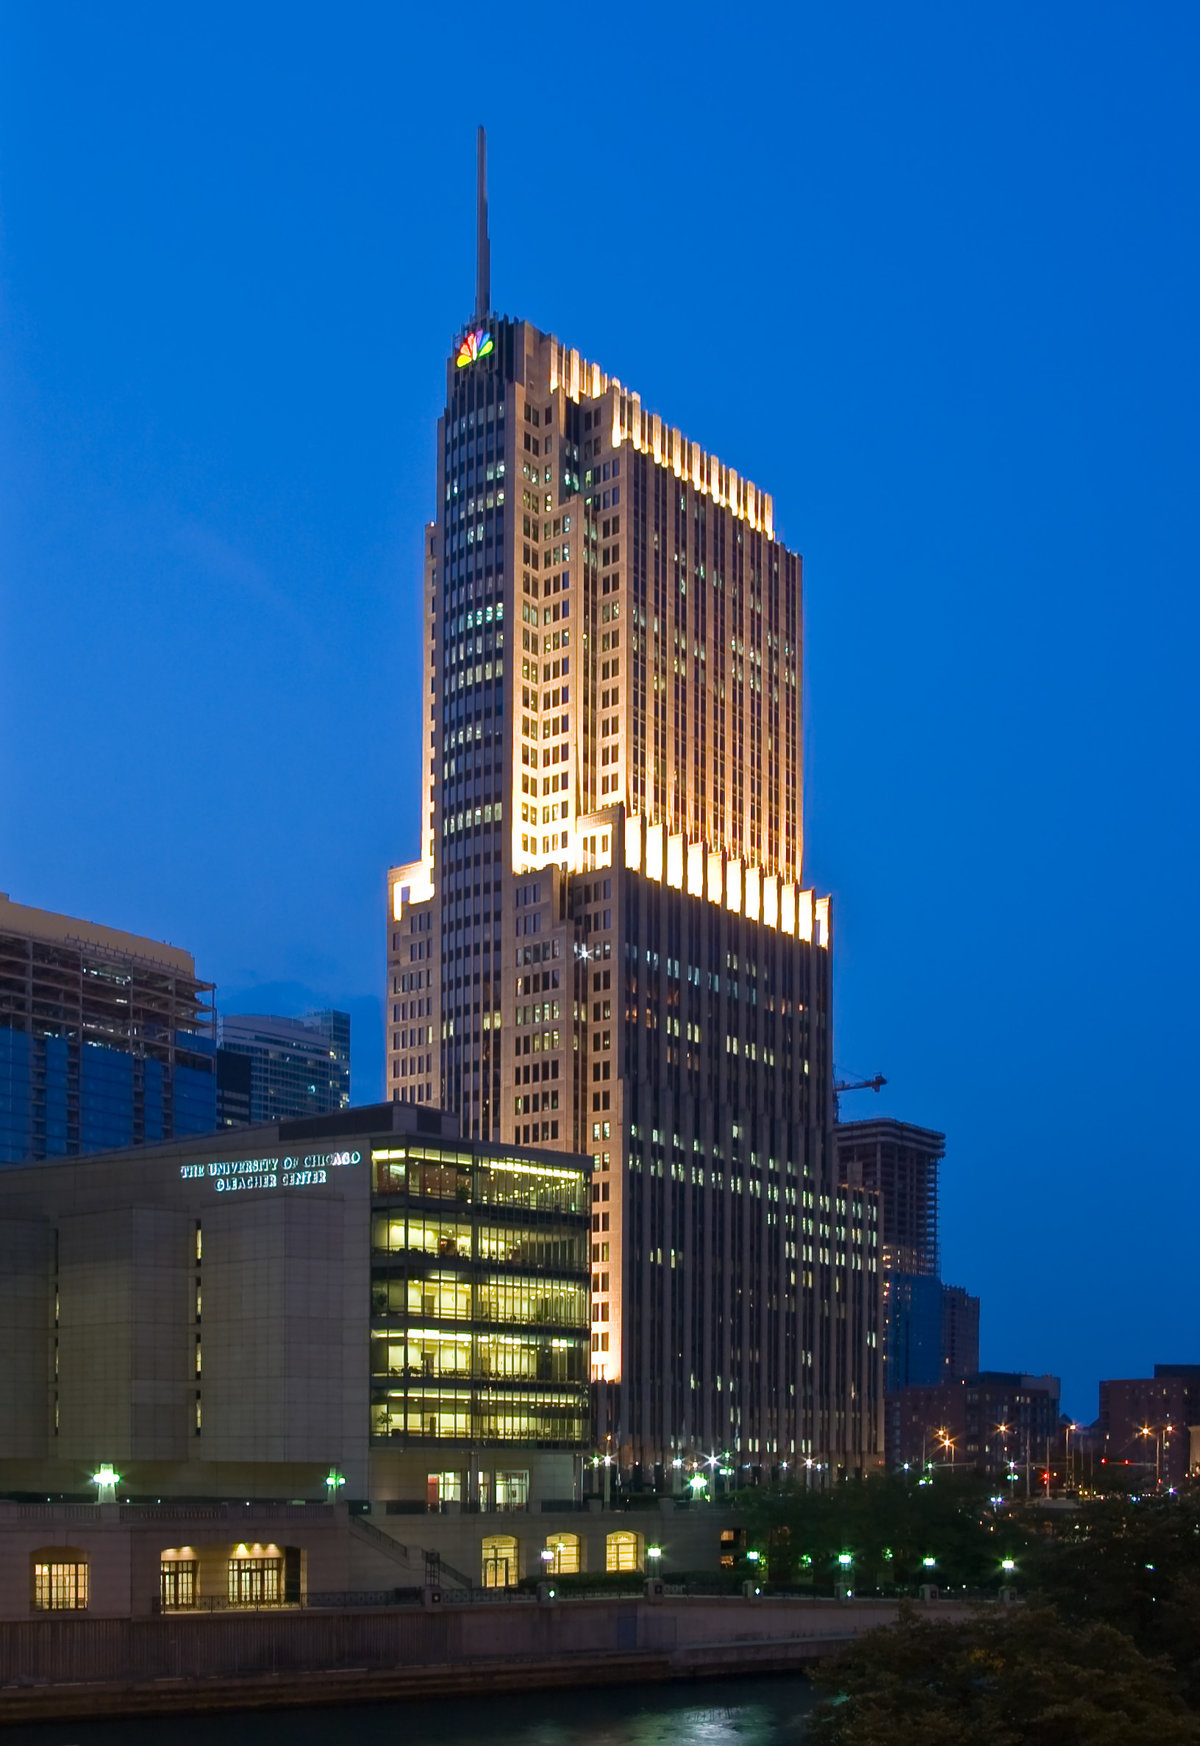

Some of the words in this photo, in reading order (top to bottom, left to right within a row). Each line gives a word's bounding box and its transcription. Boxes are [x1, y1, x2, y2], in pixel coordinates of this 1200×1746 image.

[180, 1165, 205, 1180] THE
[207, 1158, 279, 1176] UNIVERSITY
[282, 1156, 300, 1170] OF
[304, 1151, 361, 1168] CHICAGO
[214, 1174, 278, 1192] GLEACHER
[281, 1170, 328, 1187] CENTER
